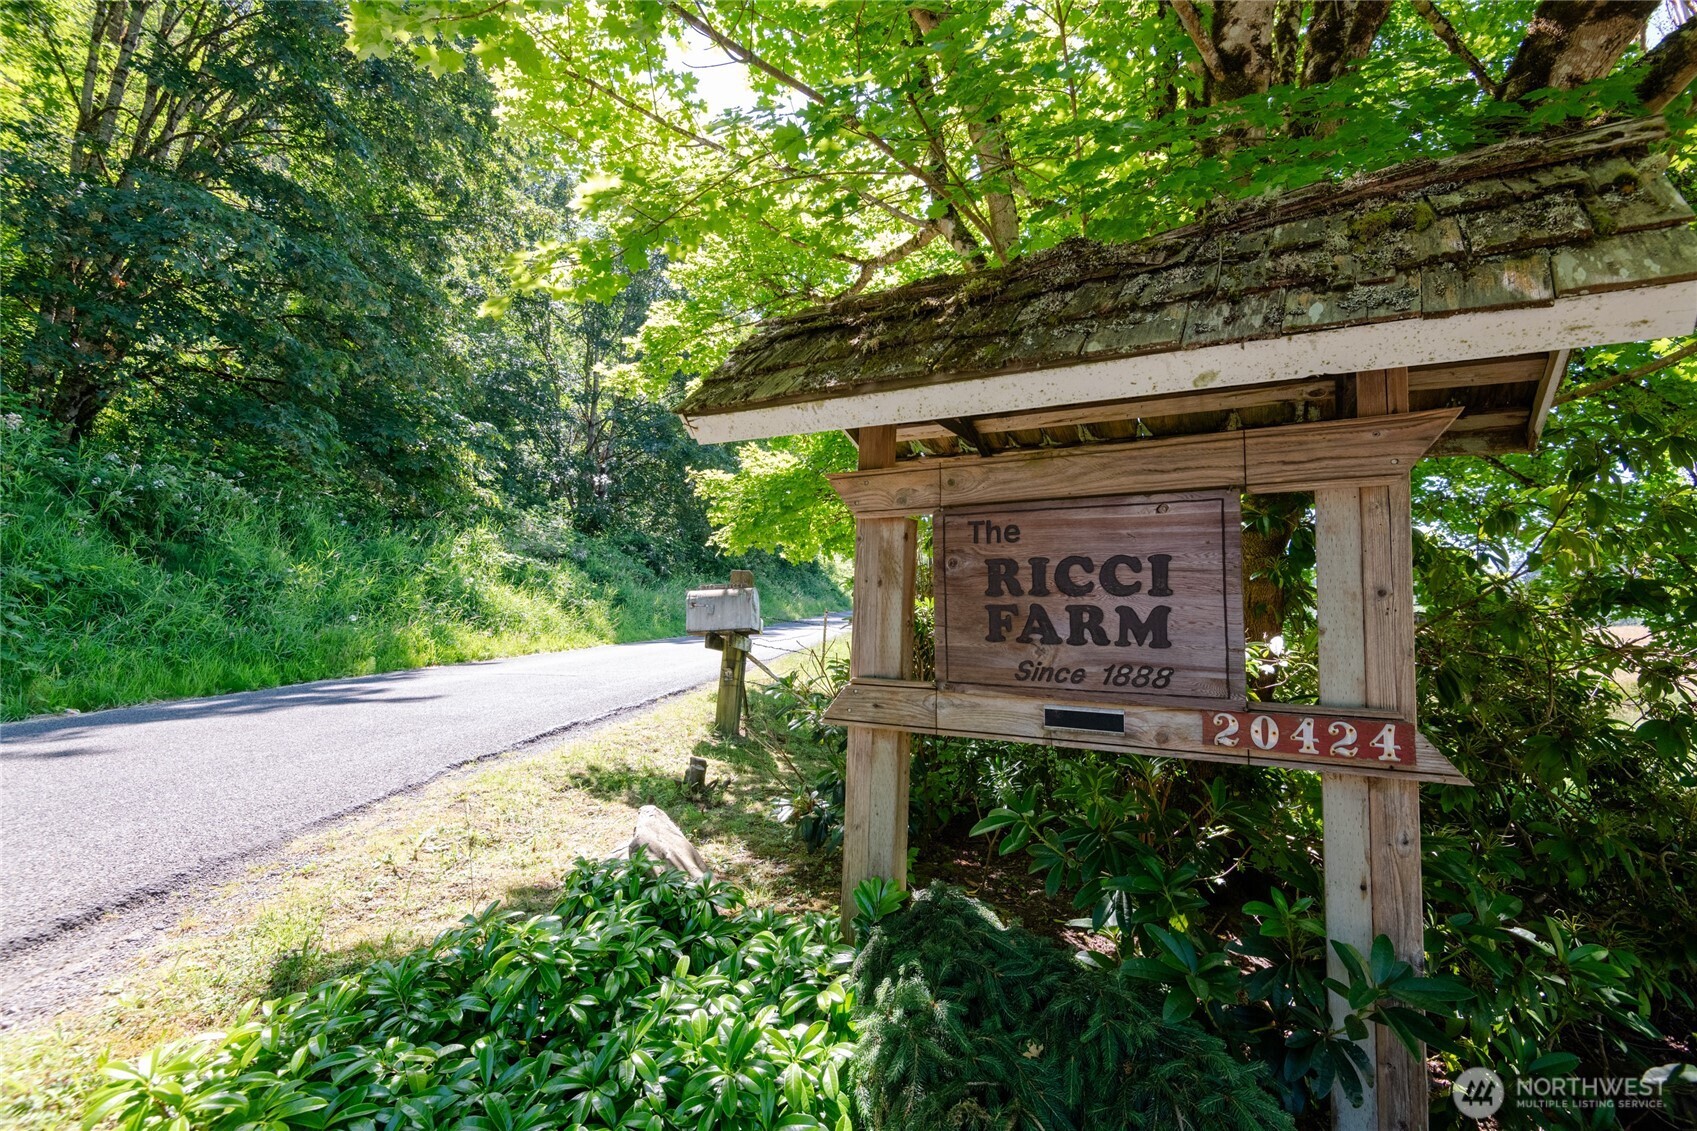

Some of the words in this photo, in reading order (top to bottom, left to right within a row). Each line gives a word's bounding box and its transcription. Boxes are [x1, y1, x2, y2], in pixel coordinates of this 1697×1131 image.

[968, 520, 1021, 544] The
[984, 554, 1173, 597] RICCI
[984, 604, 1172, 649] FARM
[1015, 660, 1086, 685] Since
[1103, 664, 1175, 689] 1888
[1213, 712, 1402, 762] 20424
